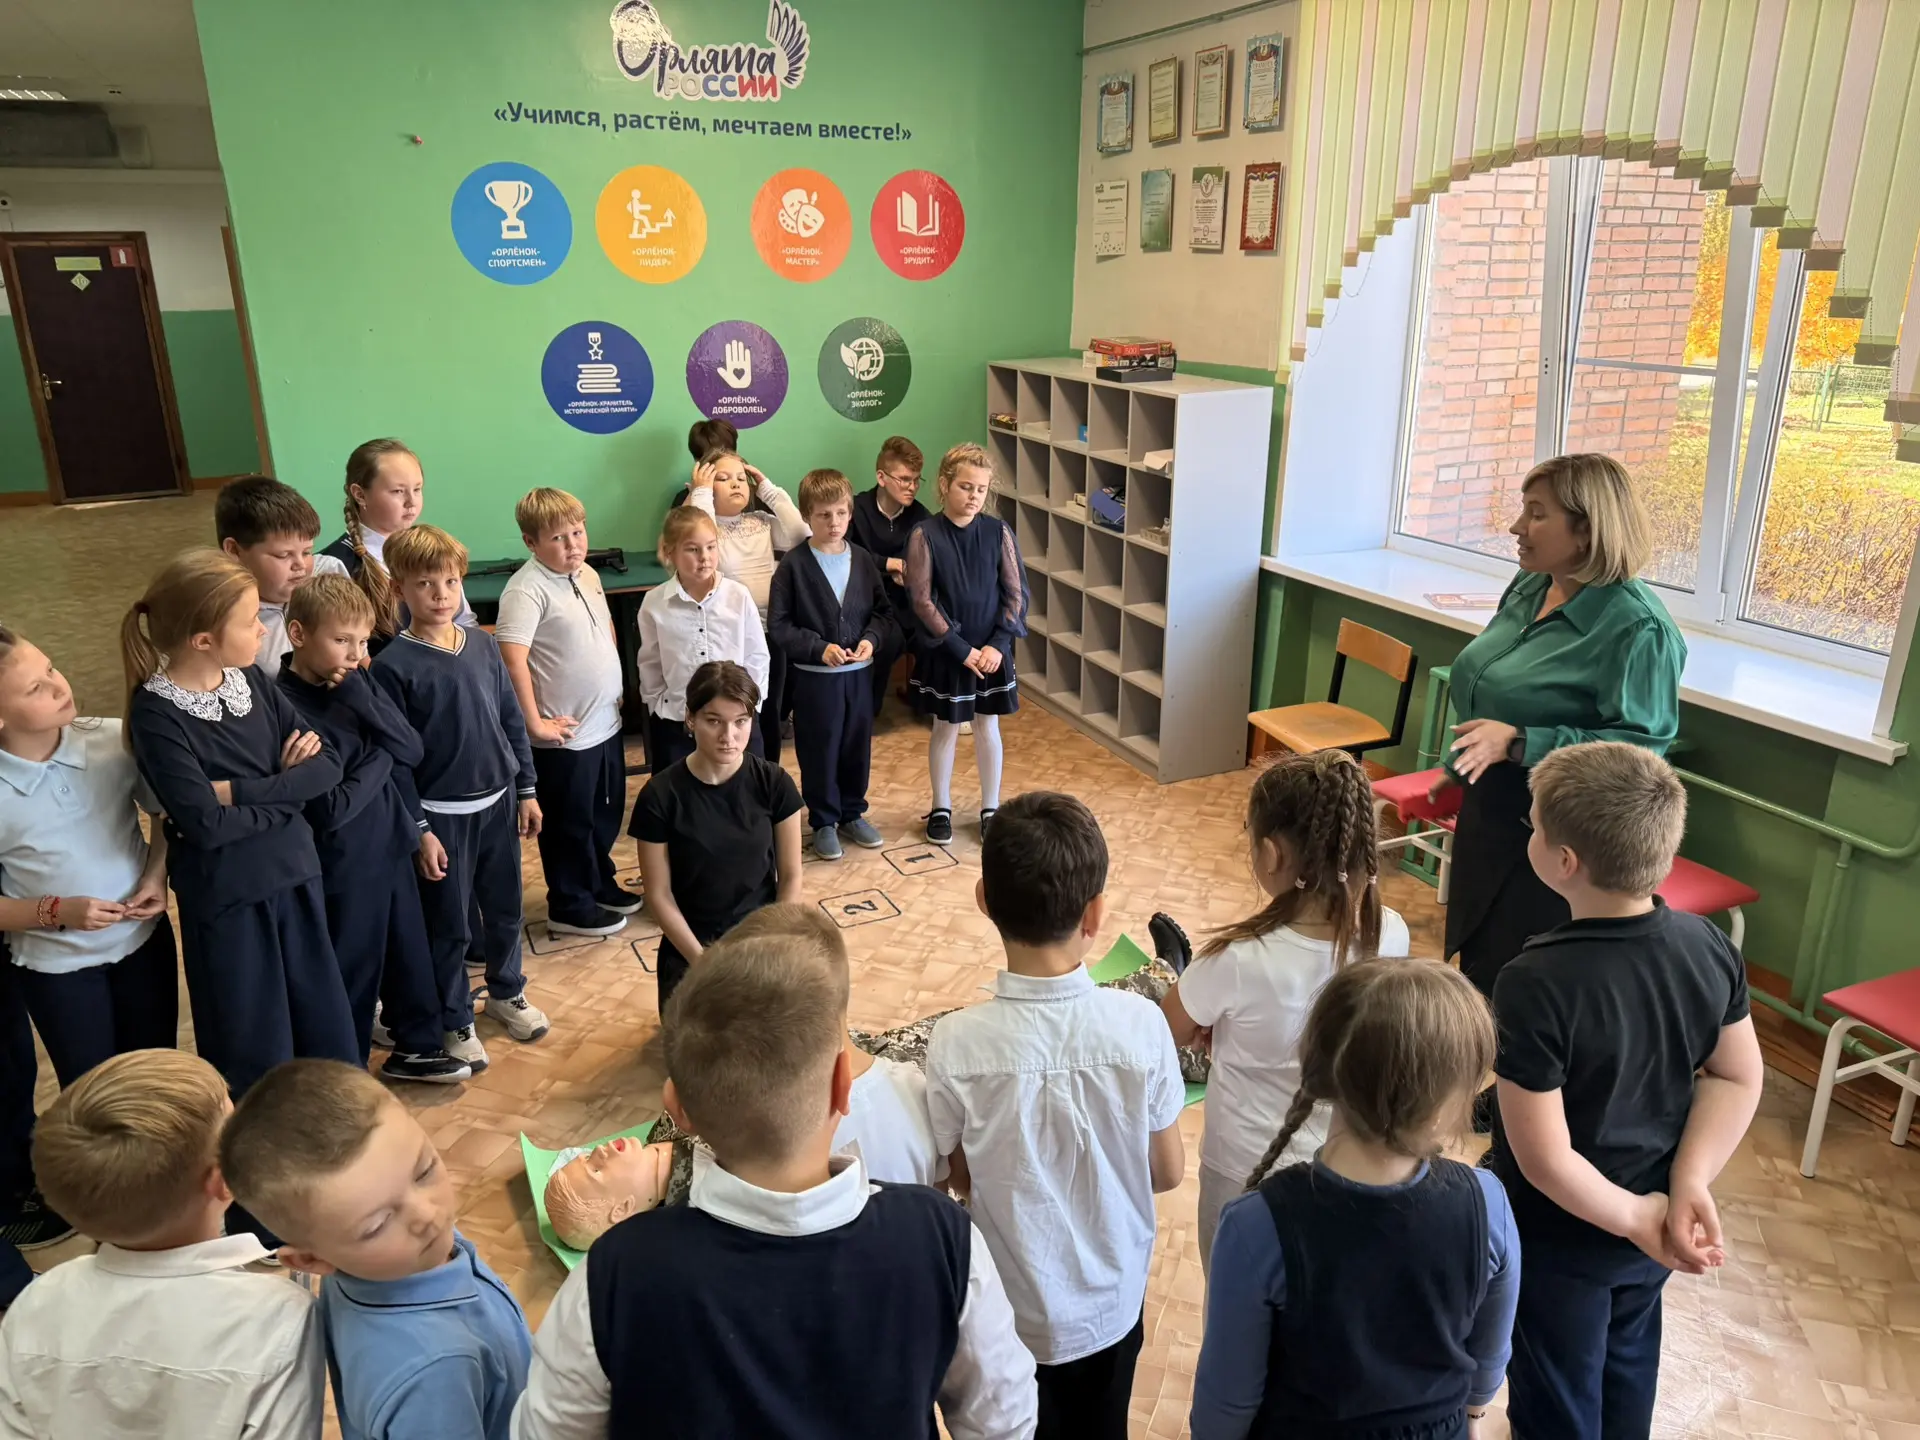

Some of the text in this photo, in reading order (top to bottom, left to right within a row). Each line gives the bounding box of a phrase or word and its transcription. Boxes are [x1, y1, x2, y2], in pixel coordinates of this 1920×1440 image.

[663, 74, 778, 98] РОССИИ
[494, 101, 912, 141] «Учимся, растём, мечтаем вместе!»
[491, 245, 541, 256] «ОРЛЁНОК-
[488, 258, 547, 268] СПОРТСМЕН»
[717, 394, 761, 404] «ОРЛЁНОК-
[851, 399, 882, 408] ЭКОЛОГ»
[712, 406, 768, 415] ДОБРОВОЛЕЦ»
[904, 852, 936, 864] 1
[843, 899, 879, 916] 2
